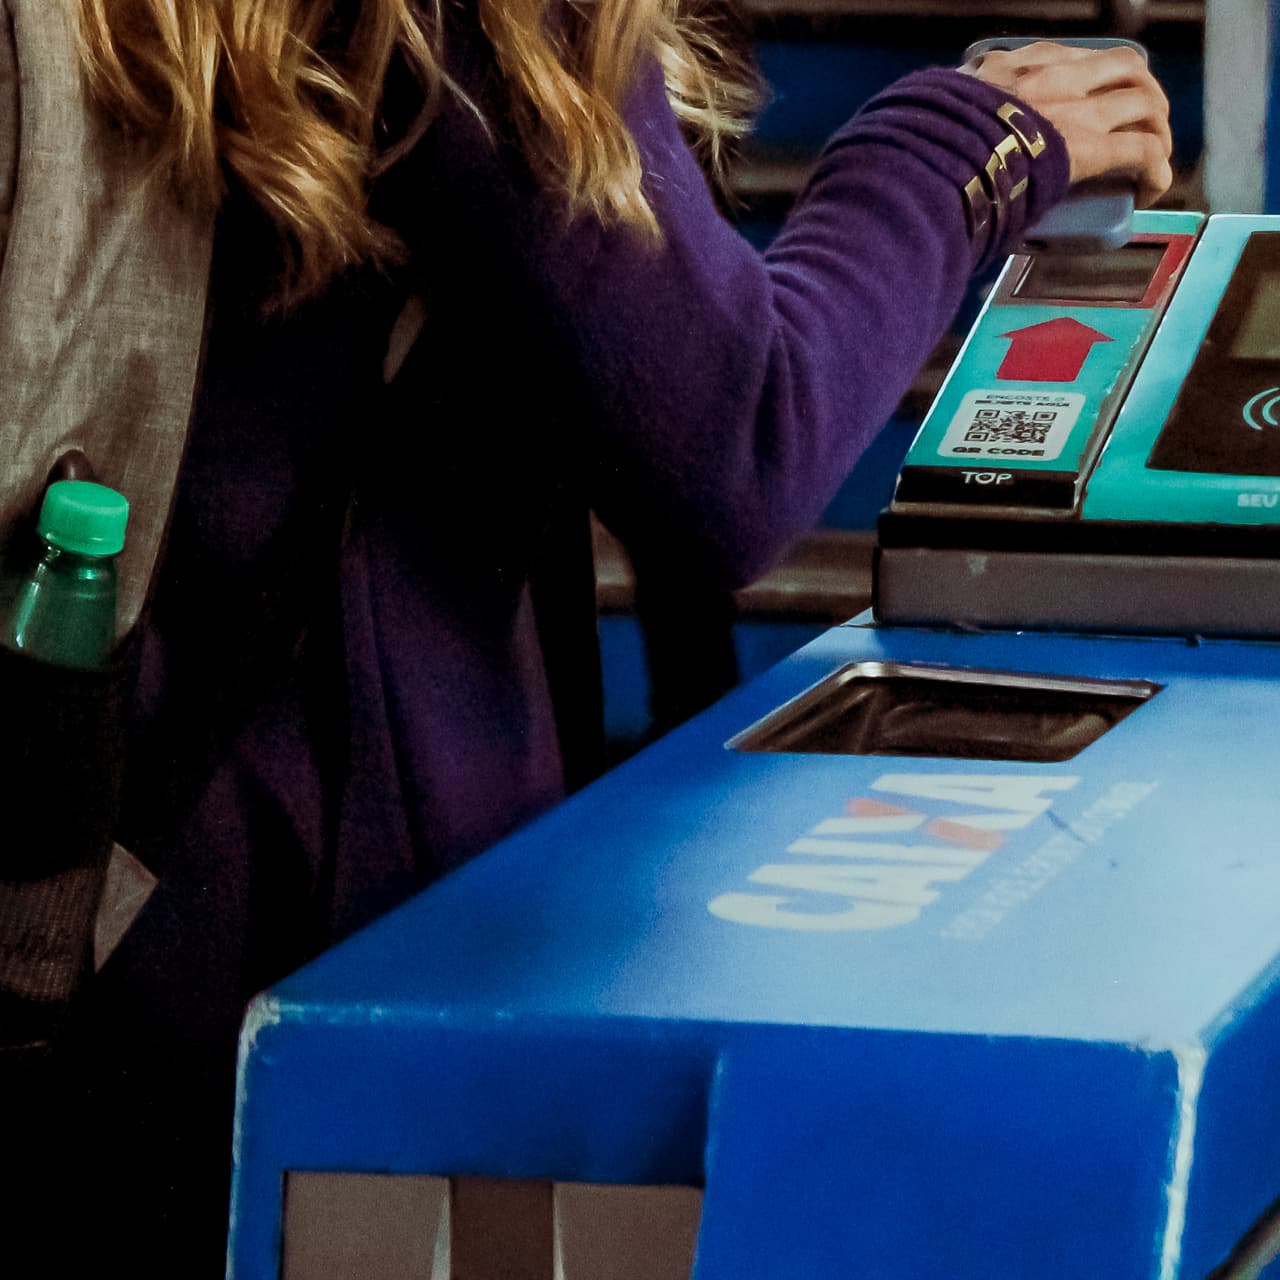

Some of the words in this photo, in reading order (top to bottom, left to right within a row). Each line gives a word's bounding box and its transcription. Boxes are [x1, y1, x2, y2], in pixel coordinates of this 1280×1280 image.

[951, 446, 982, 455] QR
[986, 447, 1046, 457] CODE
[960, 471, 1013, 485] TOP
[1237, 493, 1279, 508] SEU
[707, 773, 1082, 931] CAIXA
